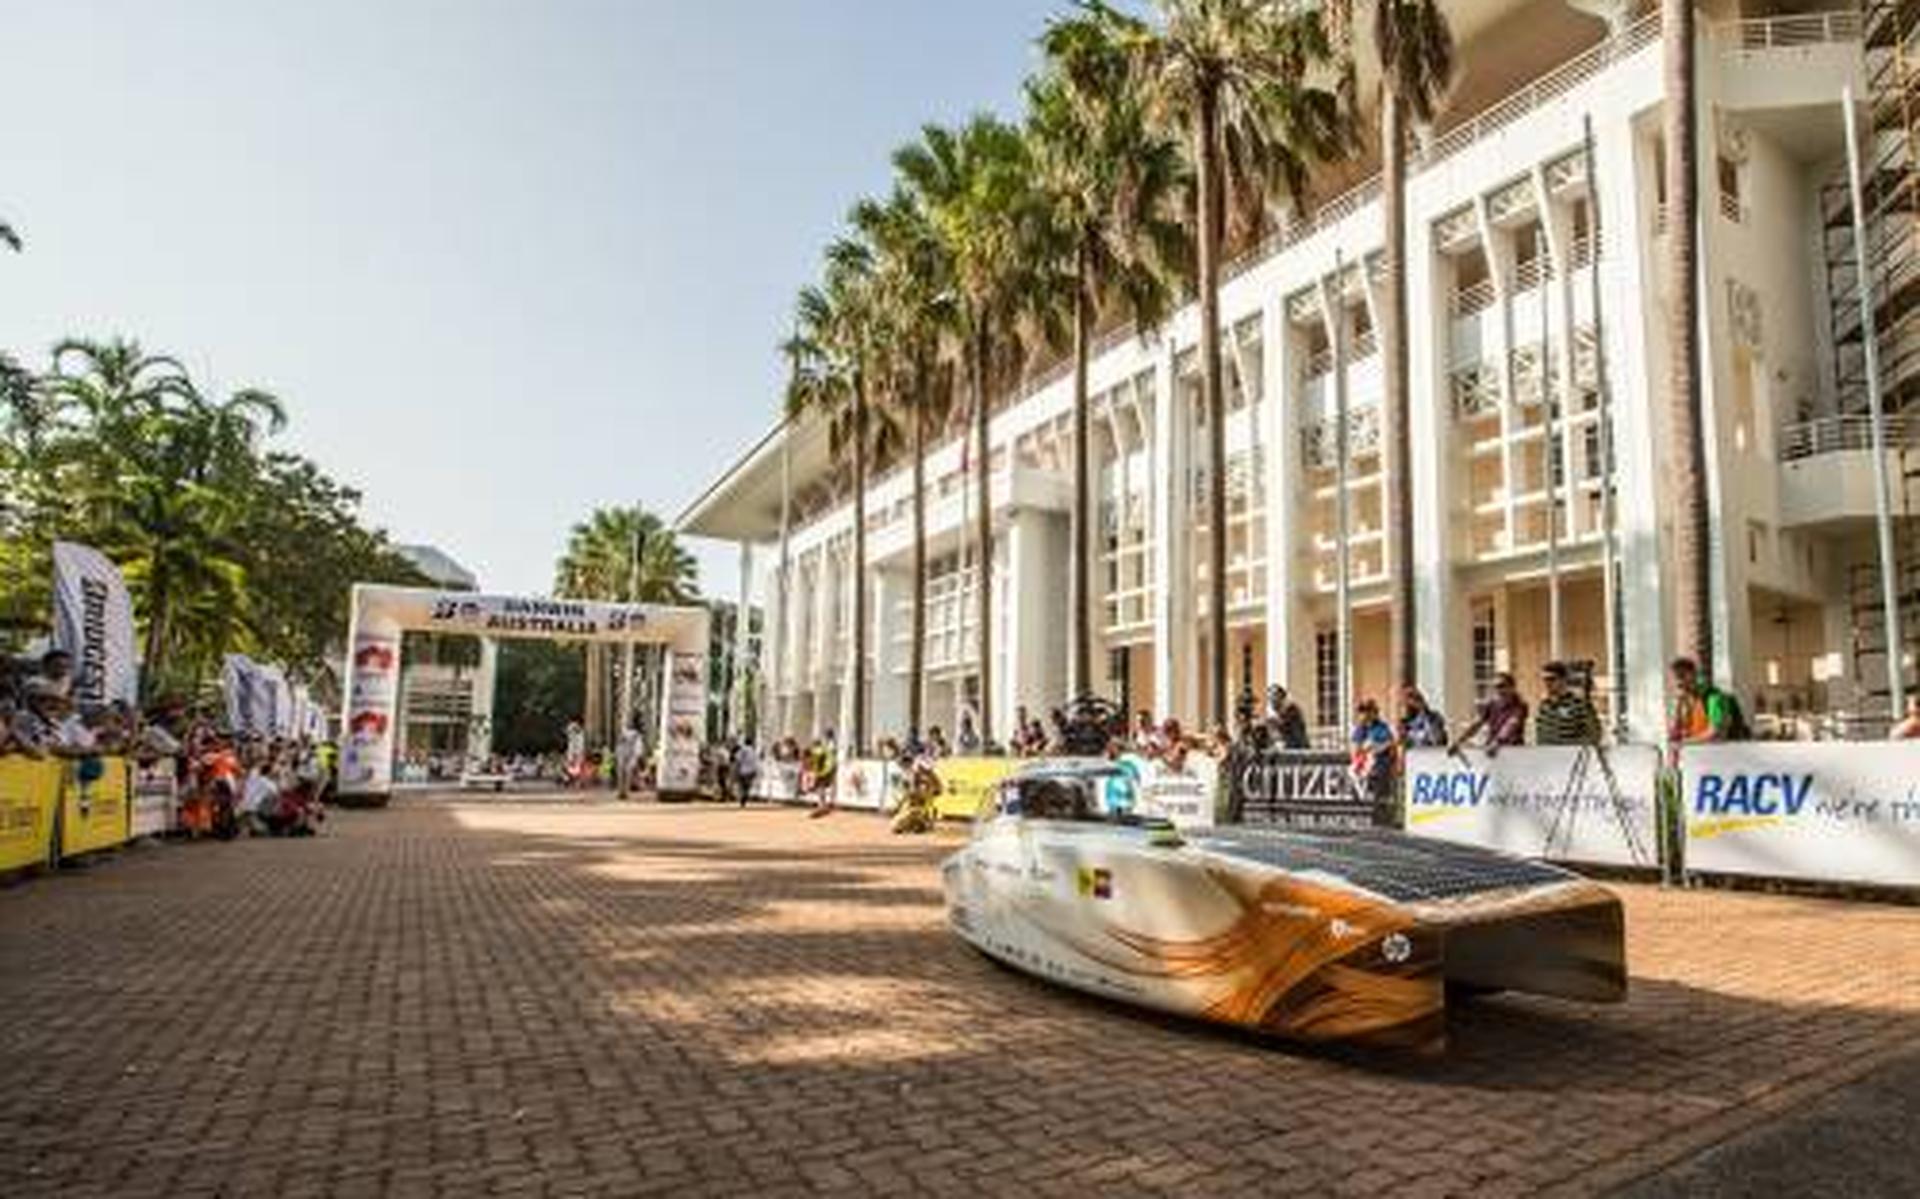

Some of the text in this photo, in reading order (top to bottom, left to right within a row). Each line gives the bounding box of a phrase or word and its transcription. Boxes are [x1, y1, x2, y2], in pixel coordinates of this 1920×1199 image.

[486, 614, 597, 634] AUSTRALIA
[1242, 763, 1369, 801] CITIZEN
[1411, 771, 1490, 807] RACV
[1695, 772, 1814, 815] RACV
